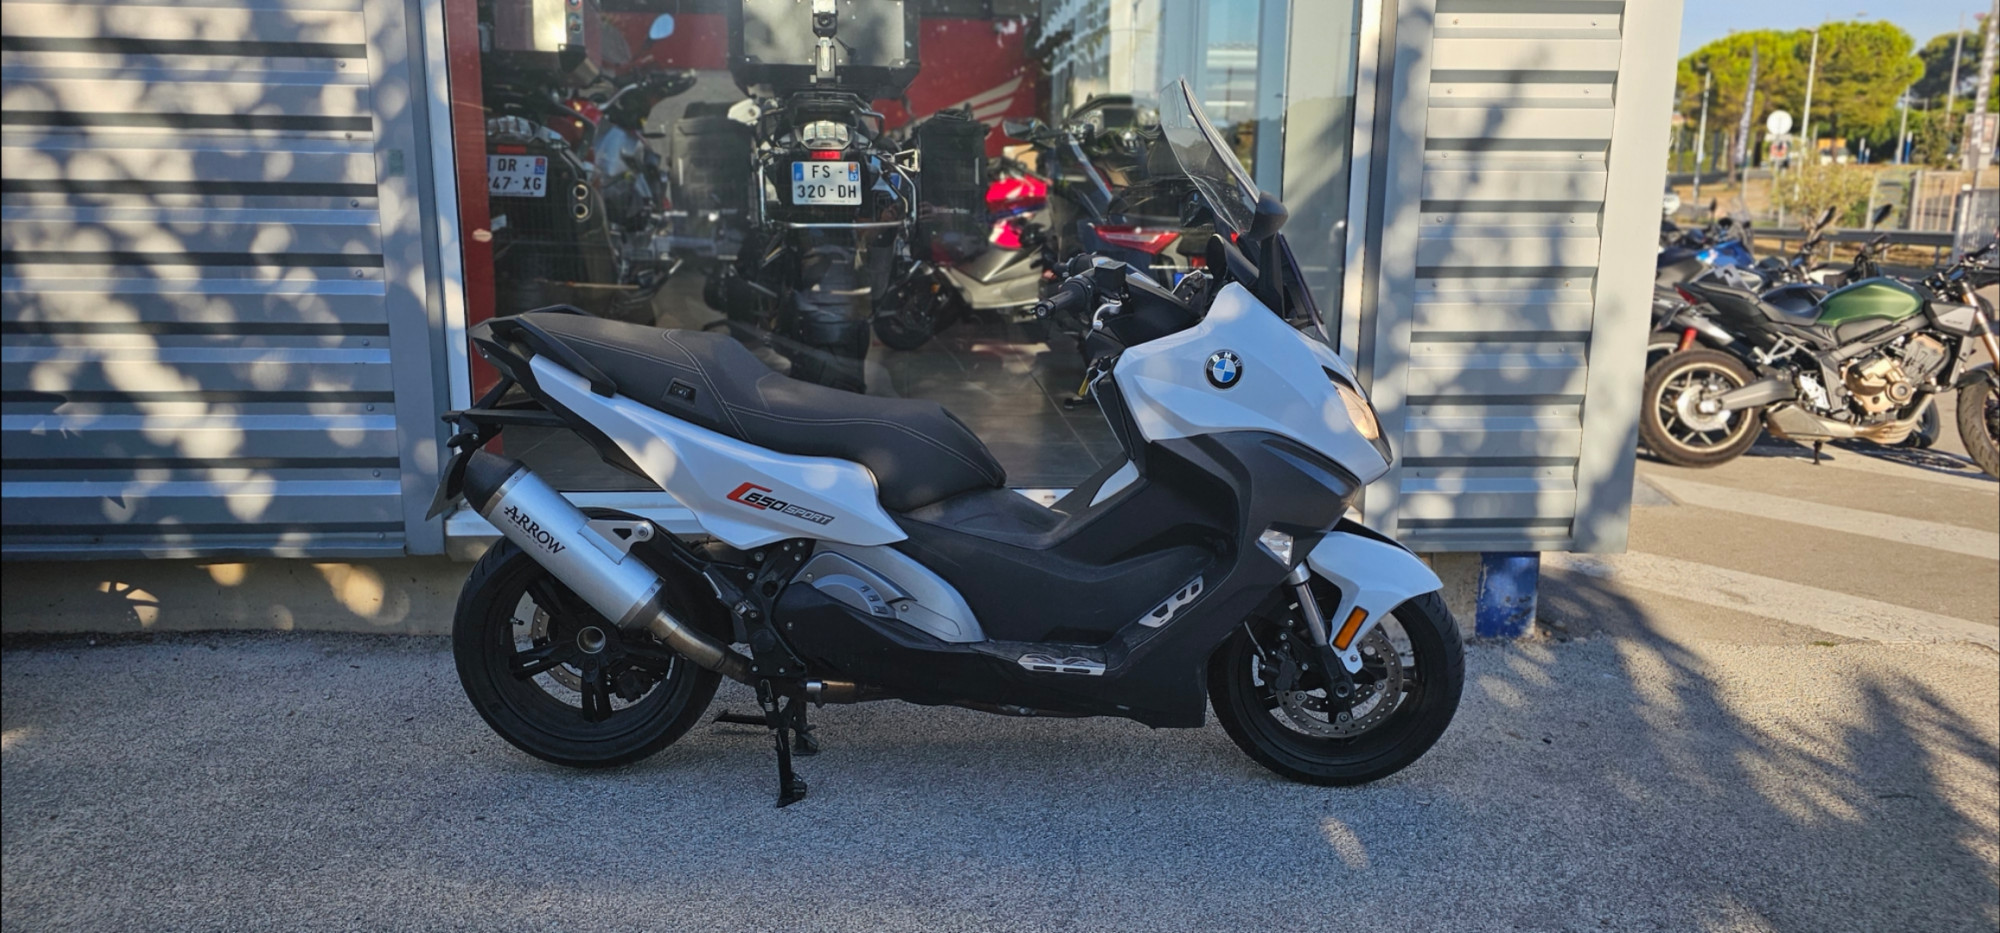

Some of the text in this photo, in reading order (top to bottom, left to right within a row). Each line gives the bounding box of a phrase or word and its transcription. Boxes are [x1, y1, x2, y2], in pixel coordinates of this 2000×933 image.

[497, 158, 517, 172] DR
[812, 164, 831, 178] FS
[488, 176, 542, 191] 47-XG
[783, 504, 835, 525] SPORT
[503, 505, 566, 554] ARROW
